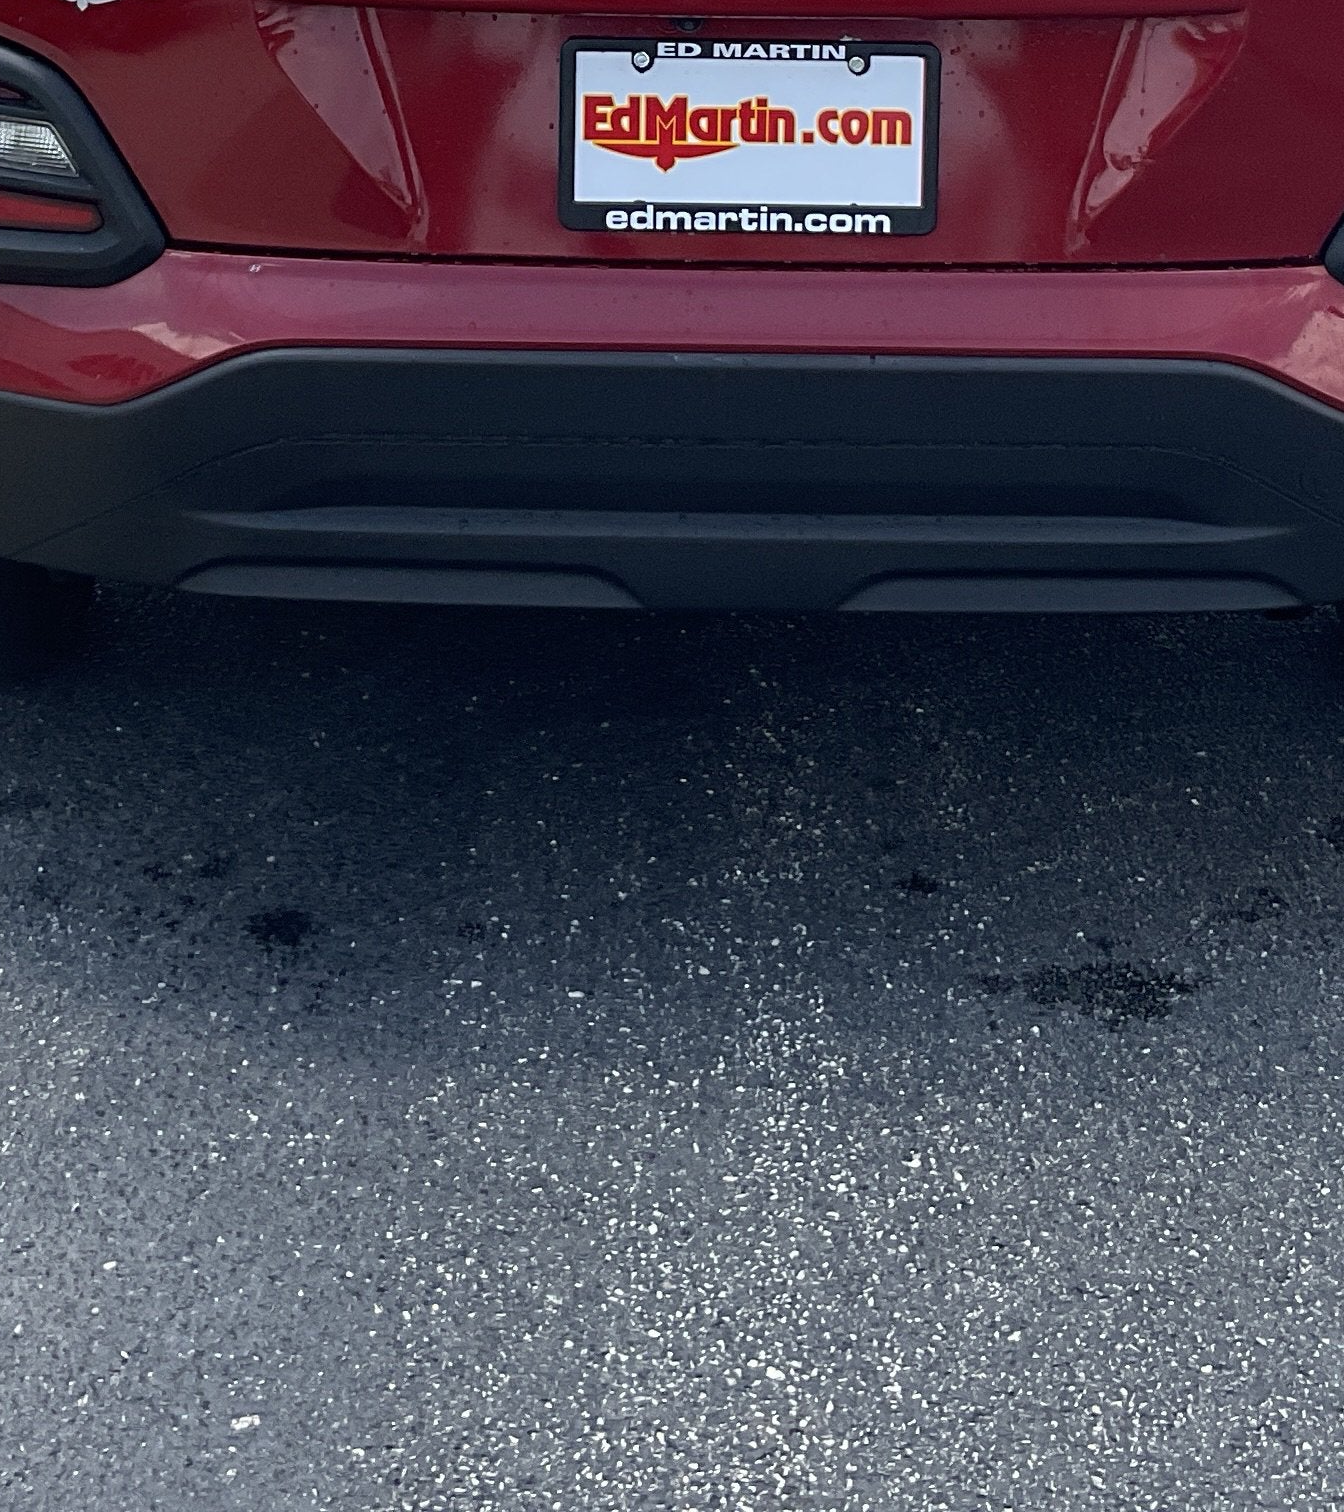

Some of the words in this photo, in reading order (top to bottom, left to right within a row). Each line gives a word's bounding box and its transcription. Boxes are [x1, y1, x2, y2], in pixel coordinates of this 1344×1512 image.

[656, 41, 702, 58] ED
[712, 42, 846, 61] MARTIN
[582, 91, 913, 148] EdMartin.com
[605, 204, 891, 234] edmartin.com
